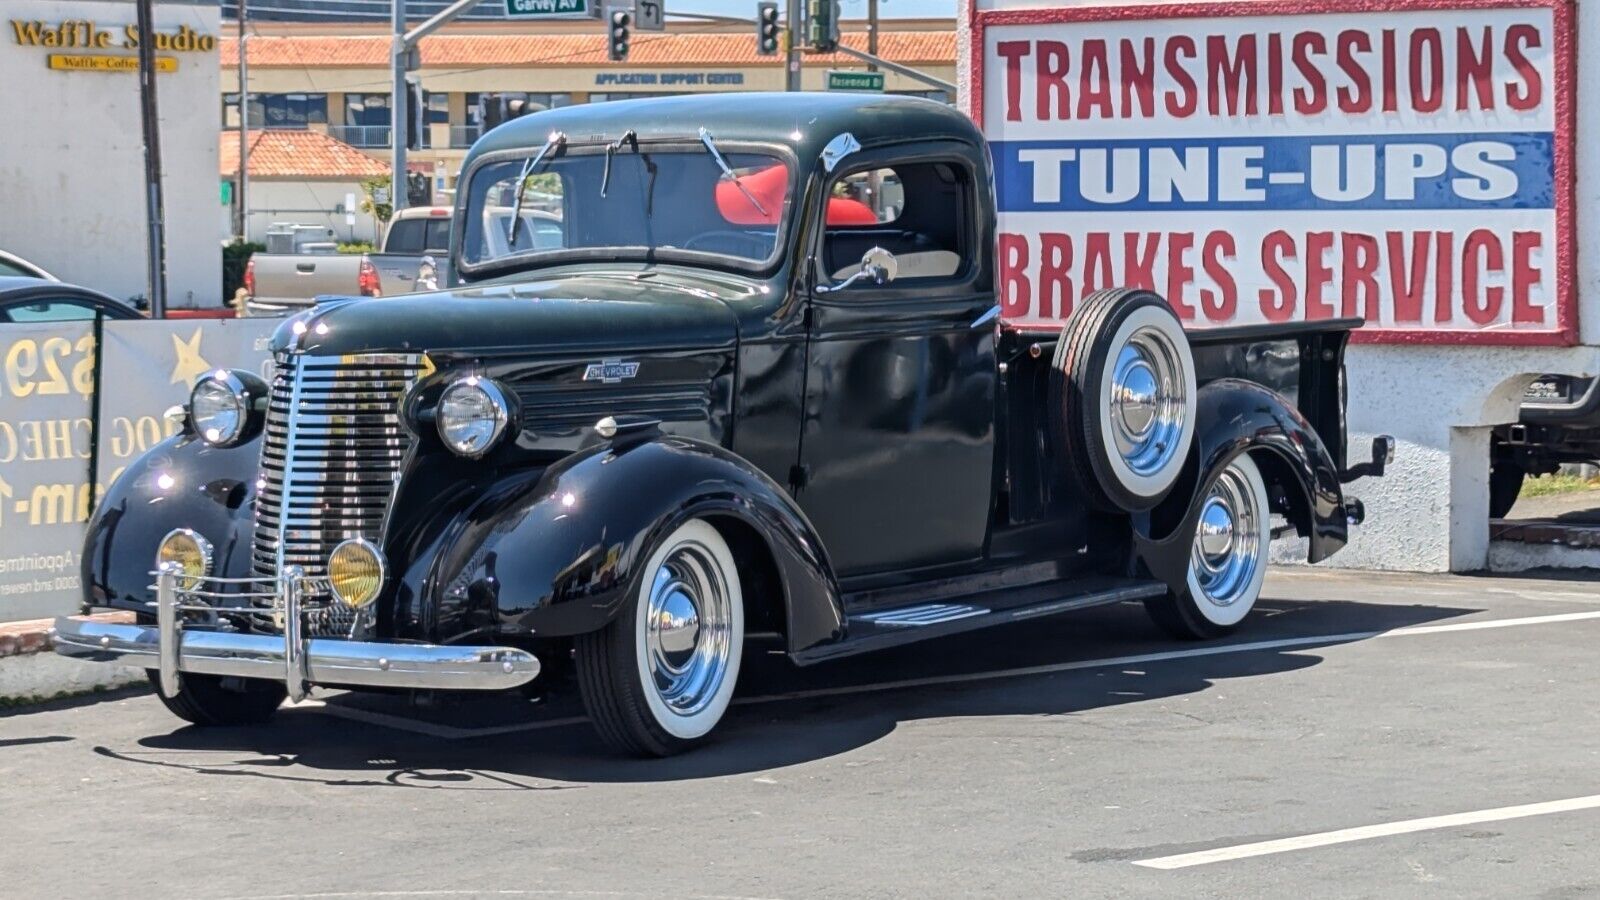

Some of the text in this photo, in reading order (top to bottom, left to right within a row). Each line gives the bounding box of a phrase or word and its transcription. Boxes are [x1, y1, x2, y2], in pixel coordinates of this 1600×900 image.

[514, 0, 556, 12] Garvey
[11, 19, 216, 51] Waffle Sudio
[595, 73, 744, 85] APPLICATION SUPPORT CENTER
[997, 24, 1543, 122] TRANSMISSIONS
[1018, 141, 1519, 203] TUNE-UPS
[999, 229, 1546, 326] BRAKES SERVICE
[589, 365, 636, 377] CHEVROLET
